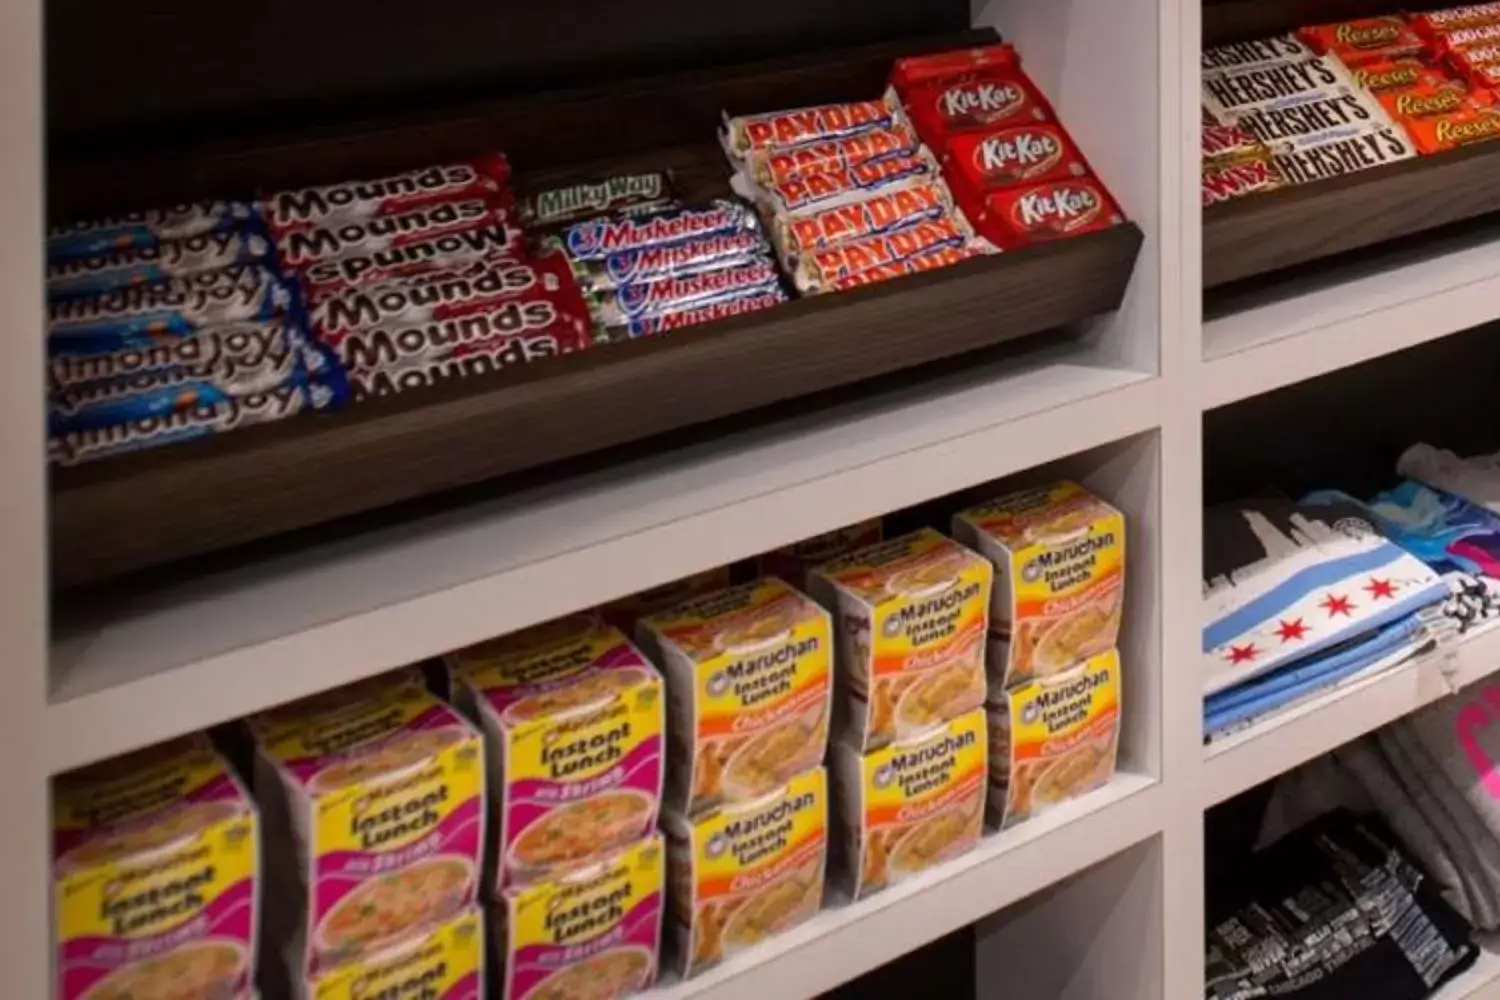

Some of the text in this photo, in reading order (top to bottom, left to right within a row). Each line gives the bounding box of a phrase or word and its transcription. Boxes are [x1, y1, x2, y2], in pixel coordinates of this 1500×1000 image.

[1206, 57, 1337, 109] HERSHEY'S
[1239, 95, 1371, 142] HERSHEY'S
[1273, 127, 1407, 185] HERSHEY'S
[276, 164, 476, 224] Mounds
[286, 200, 486, 262] Mounds
[326, 265, 535, 333] Mounds
[346, 301, 555, 370] Mounds
[1037, 532, 1115, 569] Maruchan
[1044, 556, 1097, 583] Instant
[1050, 570, 1091, 592] Lunch
[899, 582, 981, 622] Maruchan
[905, 609, 962, 637] Instant
[911, 624, 957, 646] Lunch
[725, 634, 819, 680] Maruchan
[733, 663, 798, 697] Instant
[741, 679, 791, 706] Lunch
[1036, 668, 1110, 708] Maruchan
[1042, 694, 1093, 722] Instant
[1048, 708, 1088, 733] Lunch
[539, 722, 632, 765] Instant
[550, 746, 622, 780] Lunch
[891, 729, 976, 770] Maruchan
[897, 756, 957, 787] Instant
[904, 771, 950, 798] Lunch
[350, 784, 448, 834] Instant
[723, 792, 815, 838] Maruchan
[361, 810, 439, 850] Lunch
[731, 822, 793, 857] Instant
[738, 837, 787, 867] Lunch
[544, 882, 632, 929] Instant
[551, 906, 623, 943] Lunch
